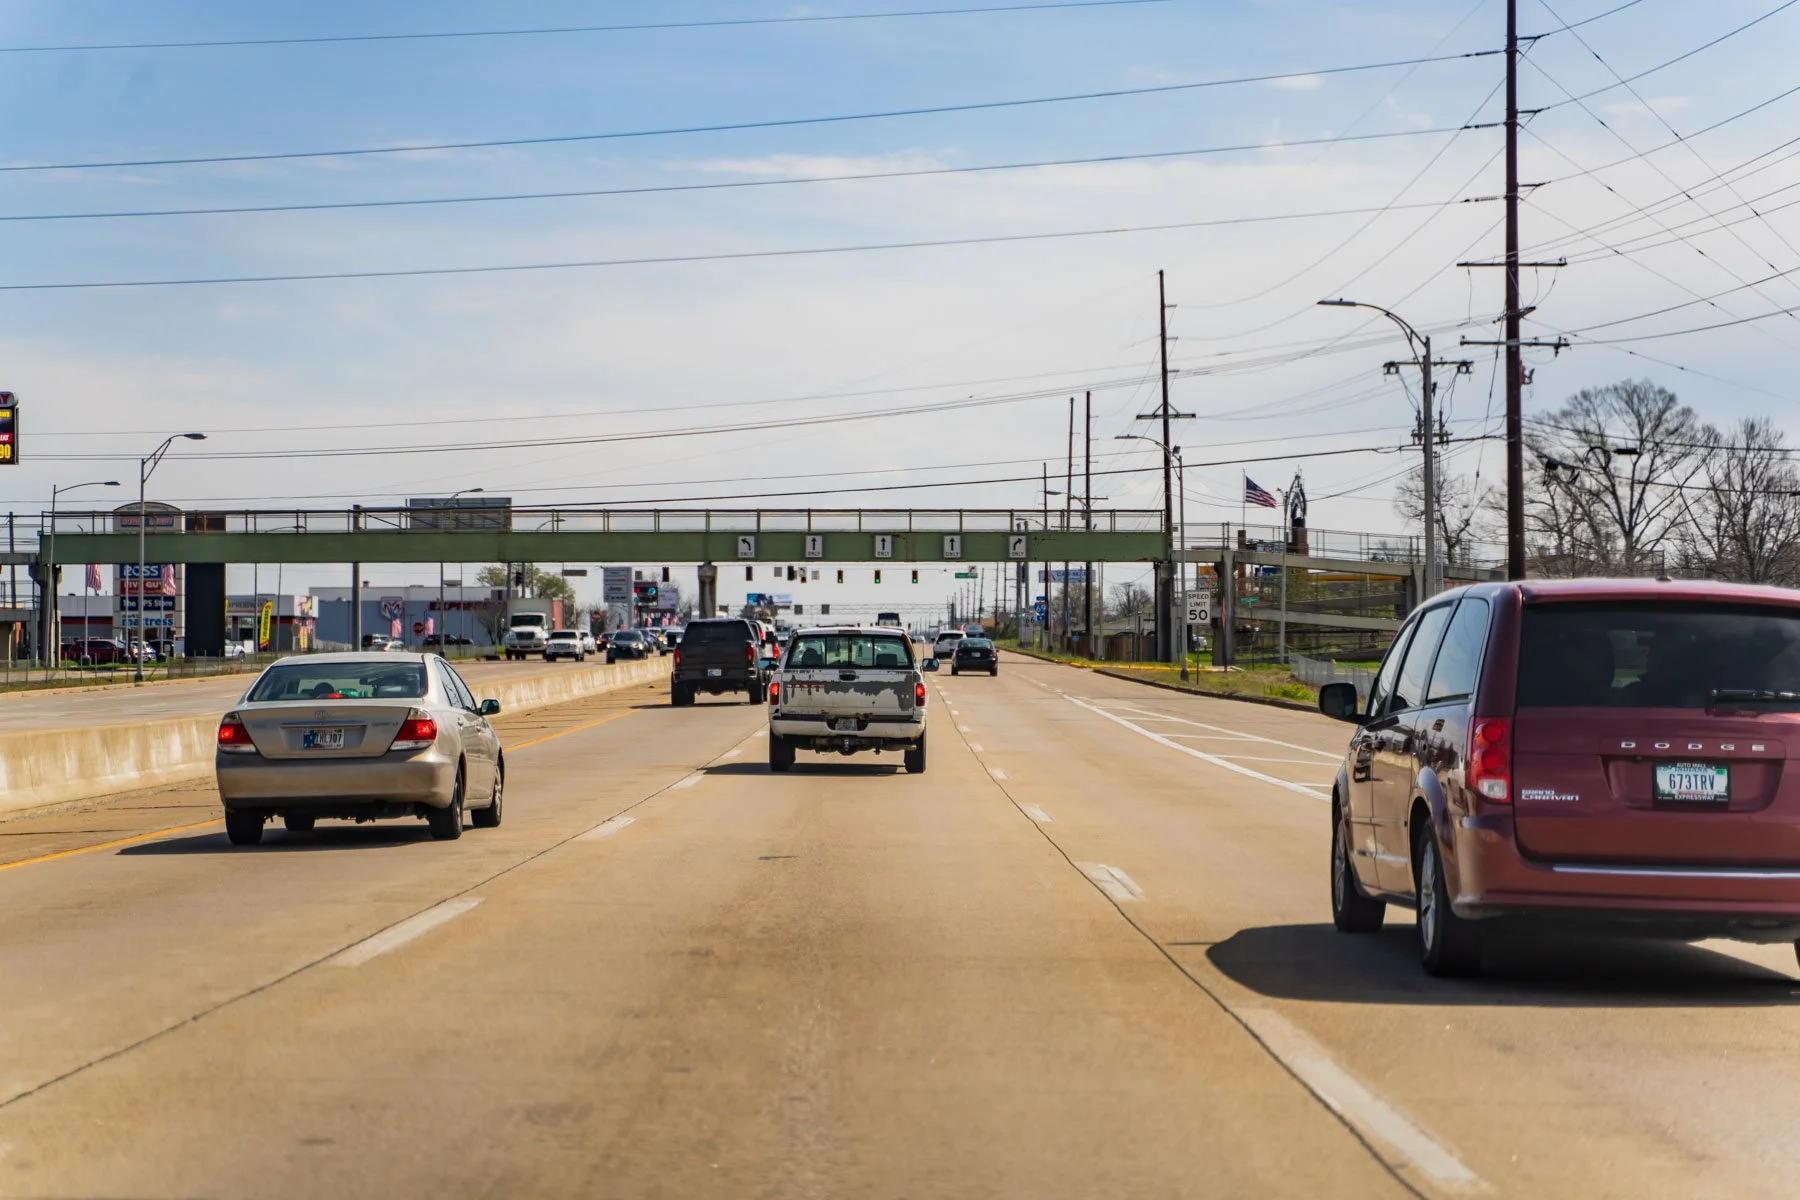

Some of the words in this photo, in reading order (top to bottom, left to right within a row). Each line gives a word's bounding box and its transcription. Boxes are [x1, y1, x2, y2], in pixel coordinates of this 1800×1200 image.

[1189, 609, 1208, 620] 50
[121, 617, 174, 626] matress
[1620, 741, 1765, 751] DODGE
[1669, 773, 1715, 790] 673TRV
